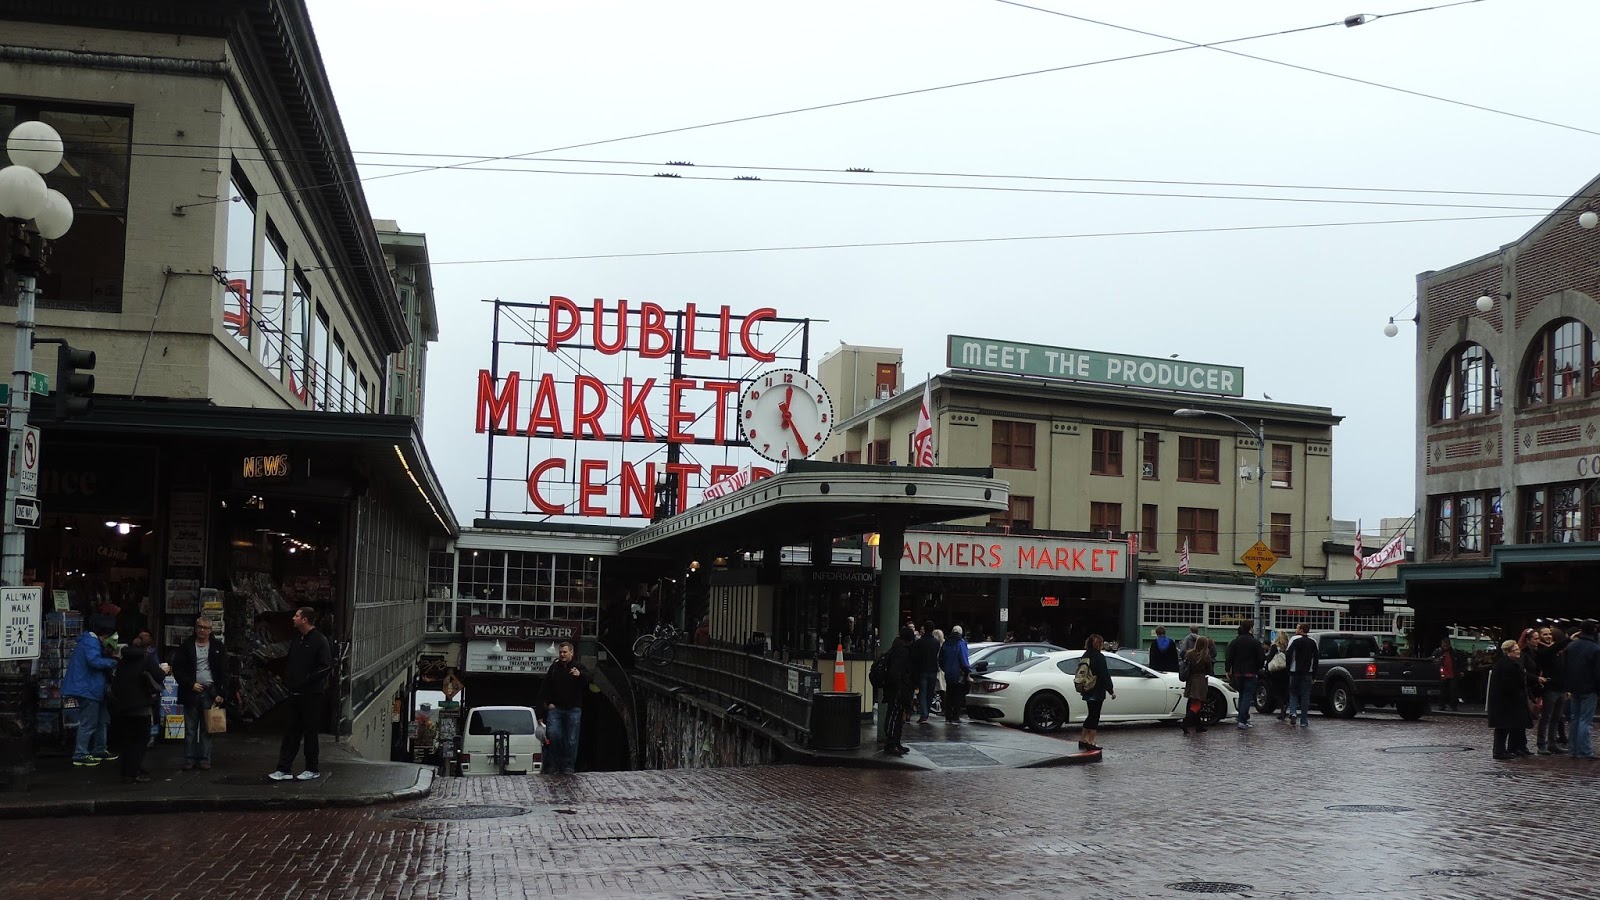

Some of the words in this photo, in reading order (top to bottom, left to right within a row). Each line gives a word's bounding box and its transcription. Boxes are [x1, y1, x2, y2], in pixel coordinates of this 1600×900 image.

[549, 296, 777, 362] PUBLIC
[962, 342, 1030, 370] MEET
[1045, 351, 1090, 377] THE
[1107, 358, 1235, 391] PRODUCER
[766, 378, 772, 387] 11
[783, 374, 793, 383] 12
[752, 391, 759, 400] 10
[818, 395, 823, 403] 2
[475, 370, 740, 445] MARKET
[746, 410, 752, 419] 9
[821, 414, 827, 423] 3
[750, 430, 756, 439] 8
[815, 433, 822, 441] 4
[763, 444, 770, 453] 7
[243, 454, 288, 478] NEWS
[22, 470, 37, 480] EXCEPT
[21, 481, 37, 492] TRANSIT
[17, 506, 25, 517] ONE
[25, 507, 33, 518] WAY
[901, 541, 1002, 569] ARMERS
[1018, 546, 1120, 572] MARKET
[812, 571, 873, 581] INFORMATION
[5, 593, 19, 601] ALL
[20, 593, 37, 601] WAY
[11, 604, 31, 612] WALK
[474, 624, 520, 636] MARKET
[524, 626, 573, 638] THEATER
